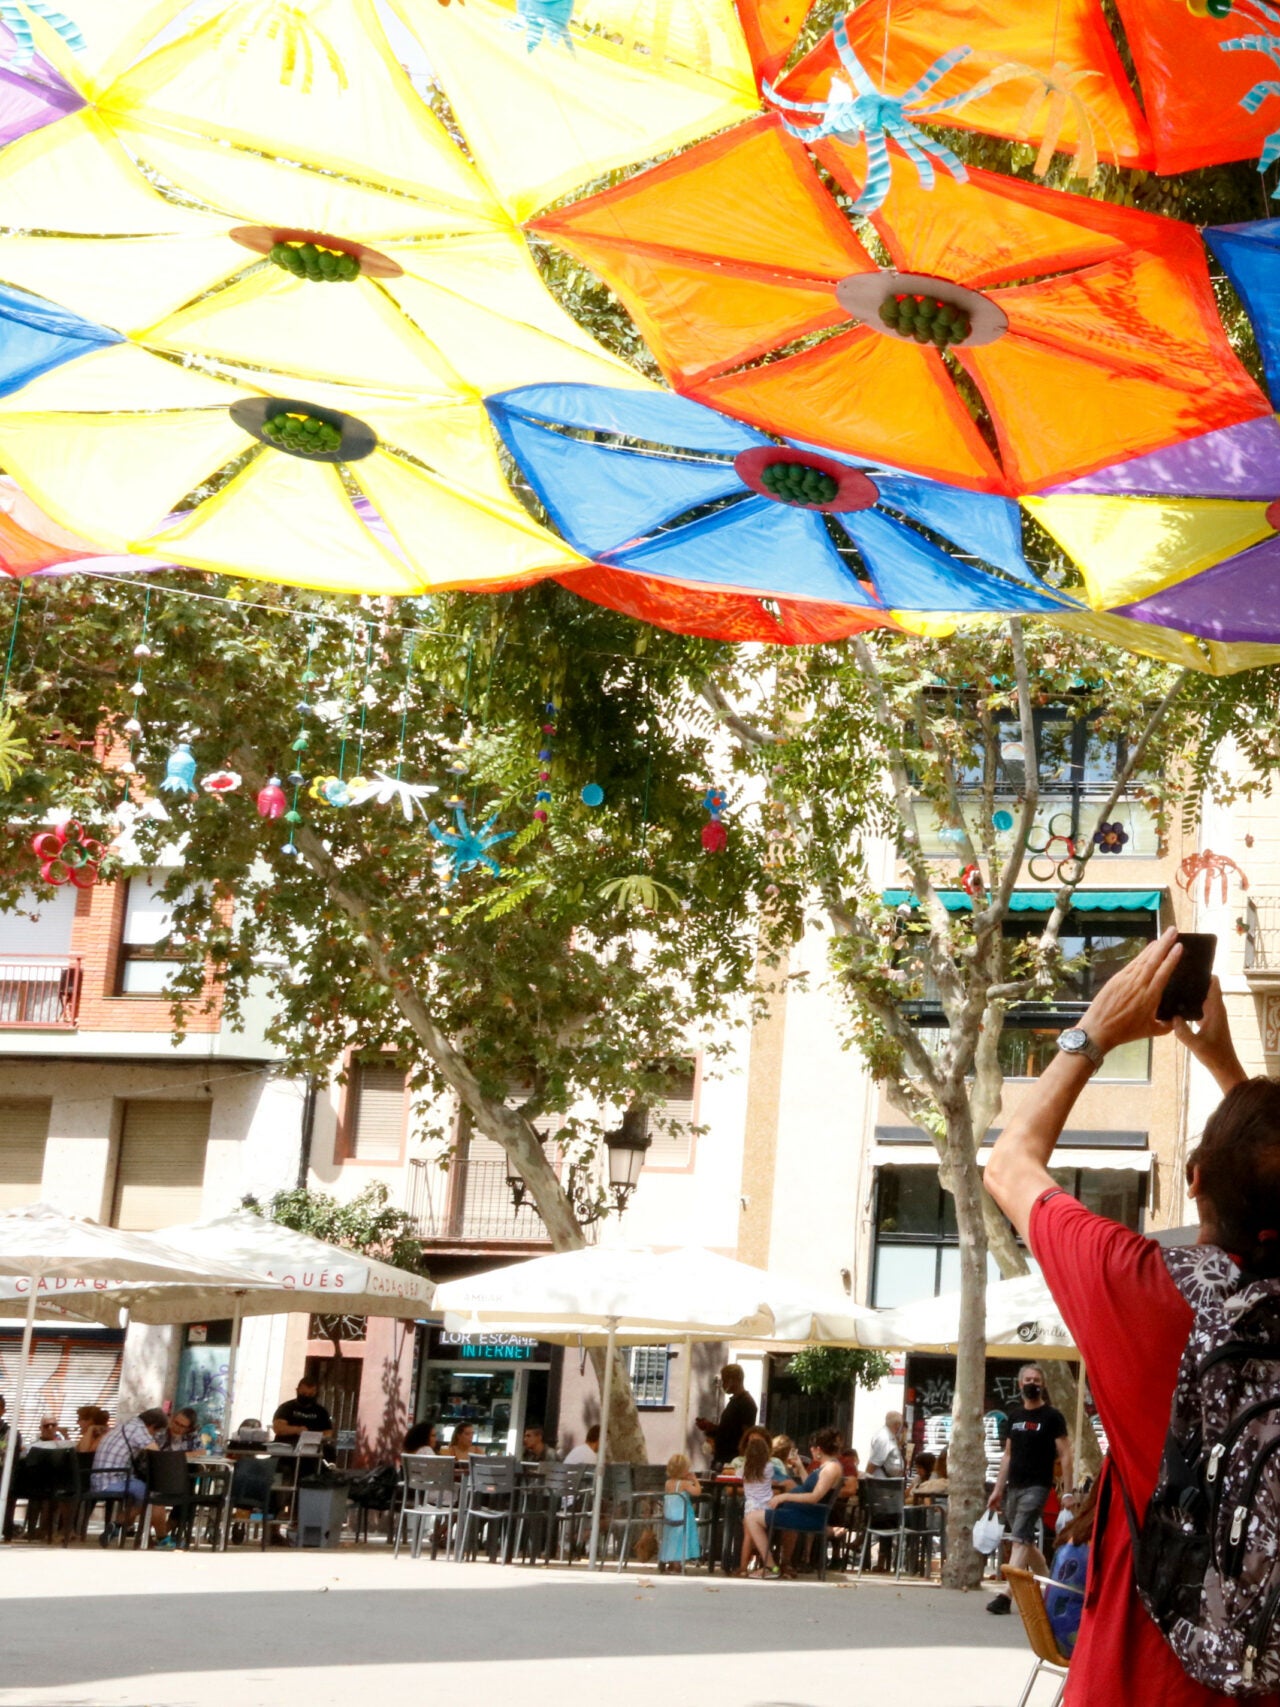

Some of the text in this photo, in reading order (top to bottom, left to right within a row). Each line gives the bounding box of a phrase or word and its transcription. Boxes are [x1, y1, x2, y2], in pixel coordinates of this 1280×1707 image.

[15, 1277, 124, 1293] CADAQ
[266, 1270, 344, 1290] QUÉS
[462, 1345, 532, 1359] INTERNET
